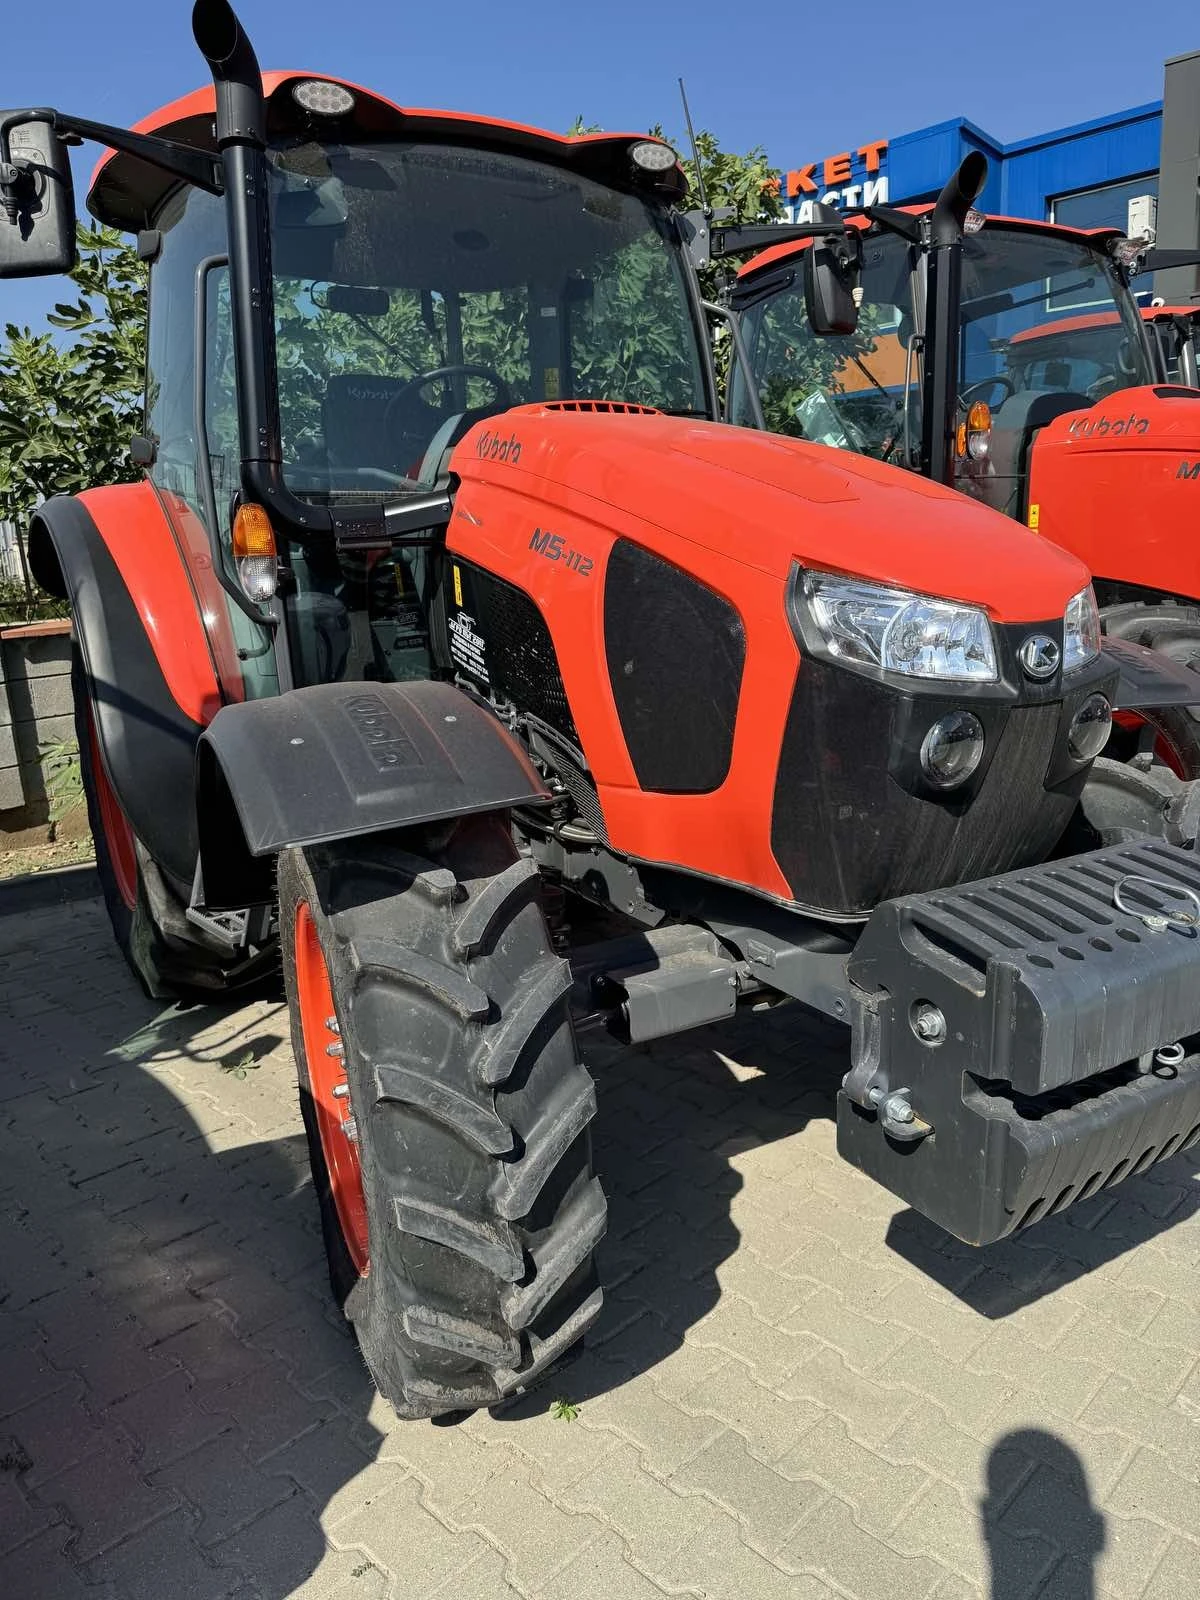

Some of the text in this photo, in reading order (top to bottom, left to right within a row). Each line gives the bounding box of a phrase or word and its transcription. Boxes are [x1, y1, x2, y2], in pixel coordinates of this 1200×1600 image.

[1069, 413, 1150, 437] Kubota
[476, 430, 522, 464] Kubota
[528, 527, 594, 577] M5-112
